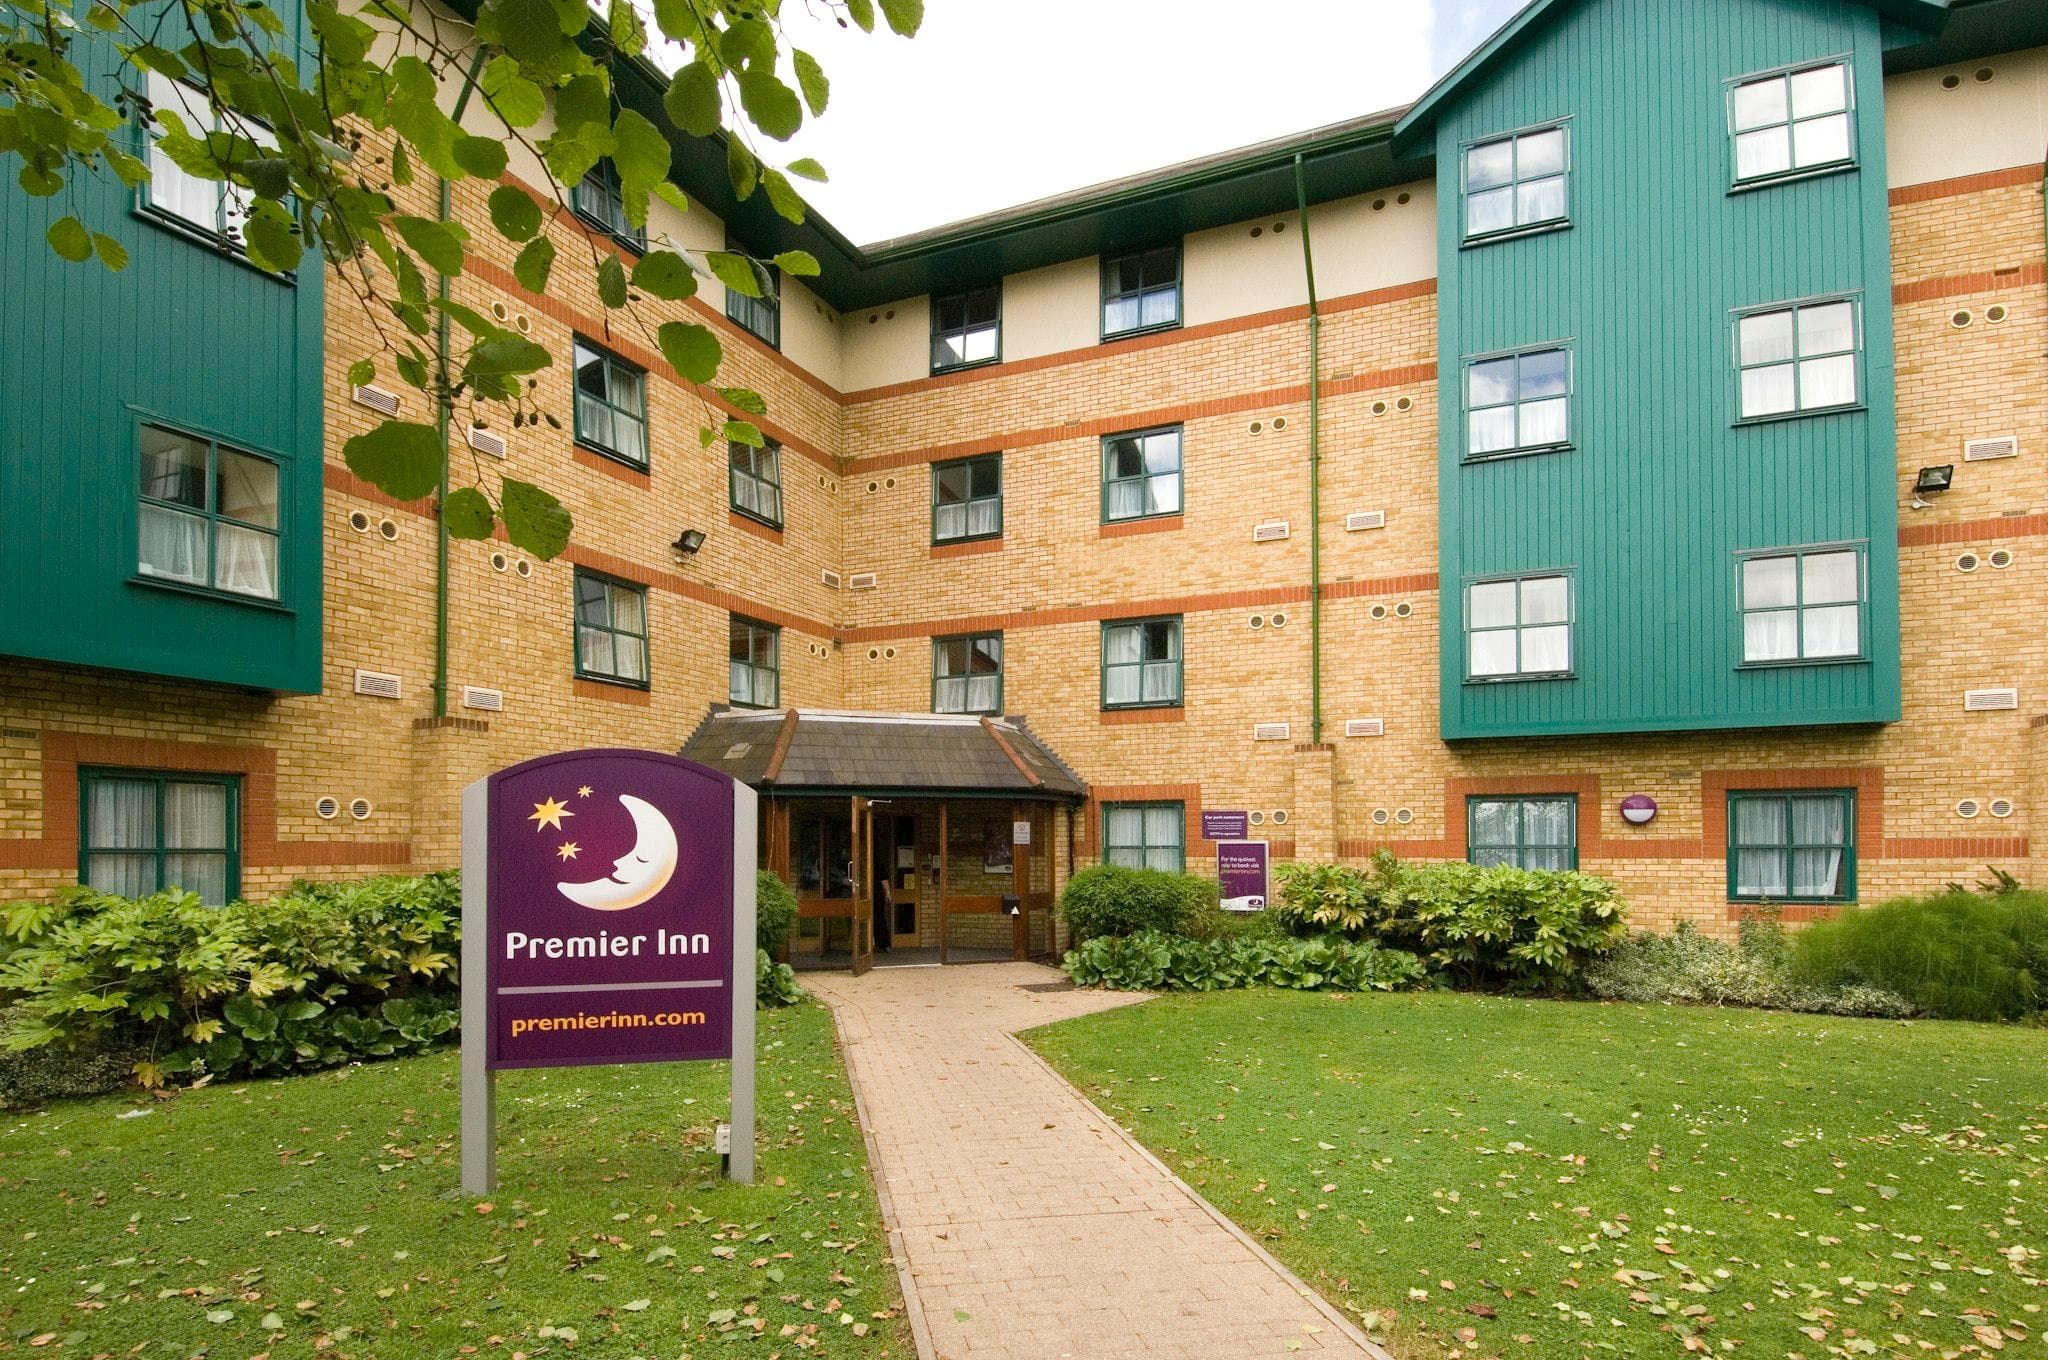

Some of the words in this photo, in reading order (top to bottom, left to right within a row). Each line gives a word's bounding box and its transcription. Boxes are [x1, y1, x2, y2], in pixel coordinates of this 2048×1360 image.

[506, 930, 647, 960] Premier
[657, 928, 710, 955] Inn
[511, 1010, 706, 1037] premierinn.com
